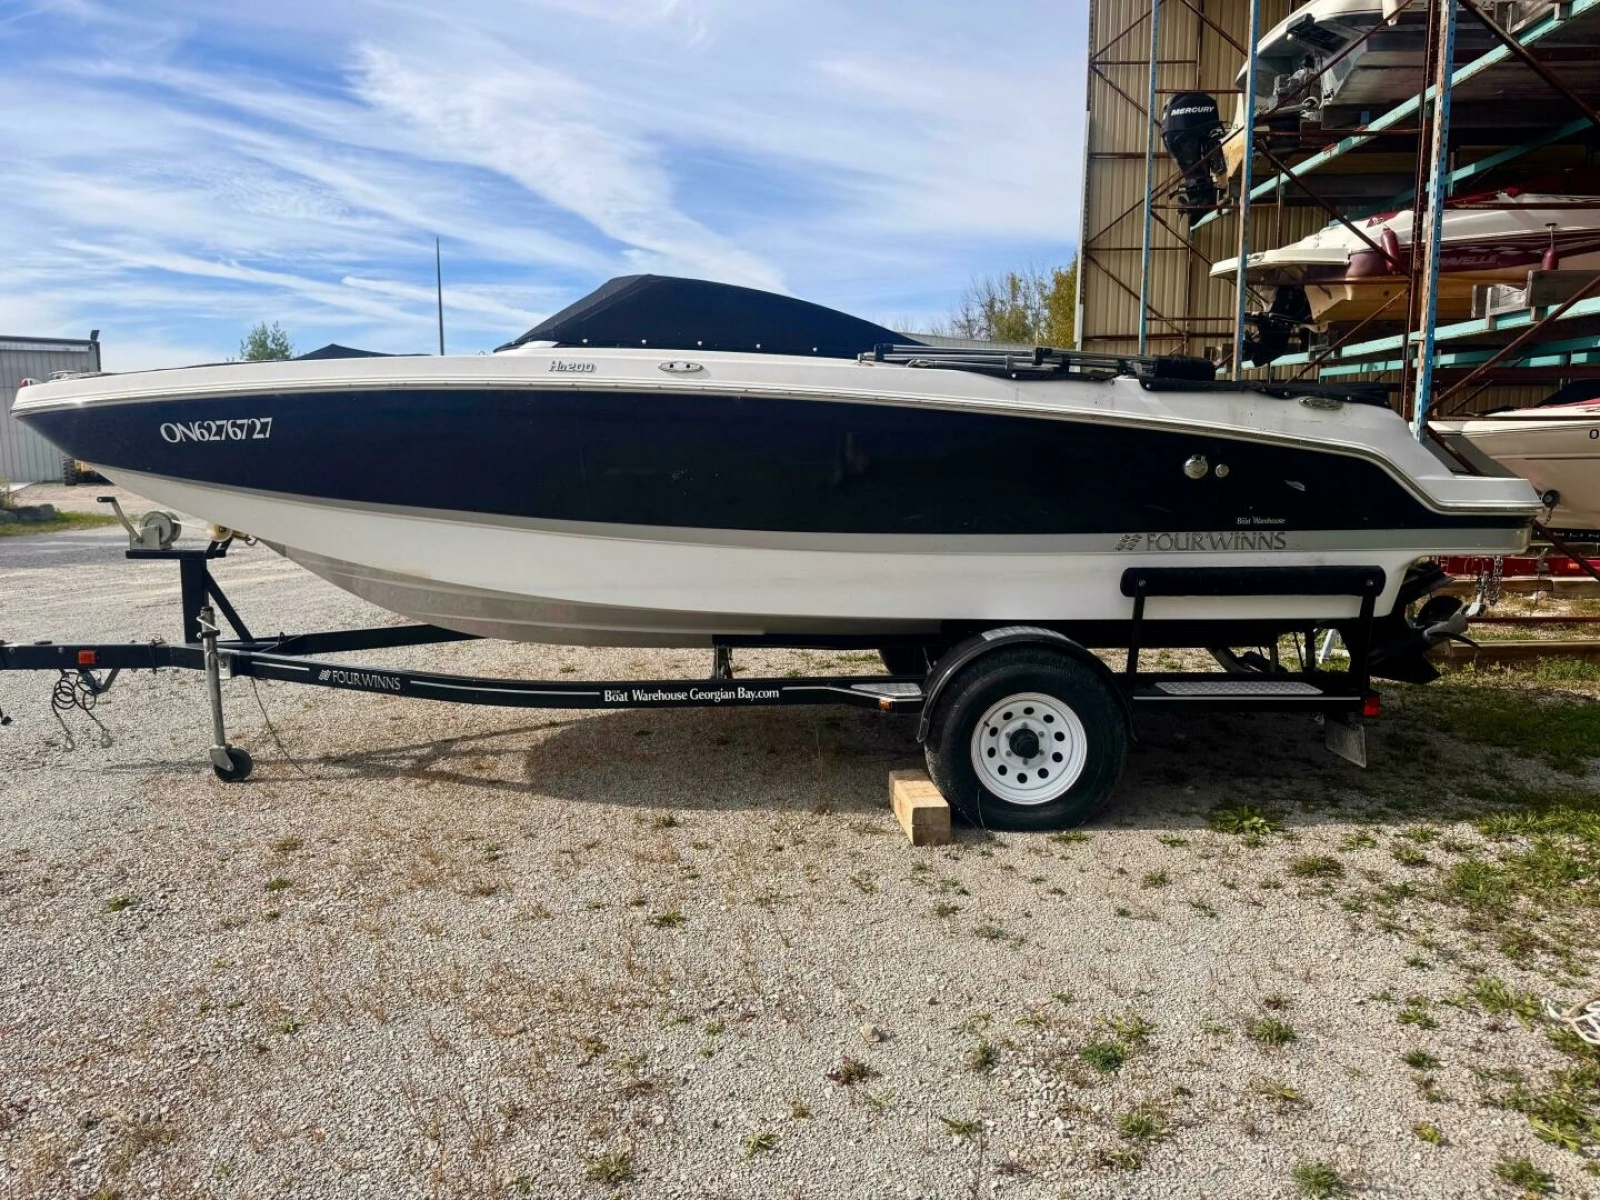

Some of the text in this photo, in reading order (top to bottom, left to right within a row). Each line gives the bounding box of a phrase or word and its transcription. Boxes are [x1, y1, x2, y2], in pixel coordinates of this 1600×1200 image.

[1171, 106, 1215, 116] MERCURY
[160, 417, 273, 443] ON6276727
[604, 687, 780, 702] Boat Warehouse Georgian Bay.com
